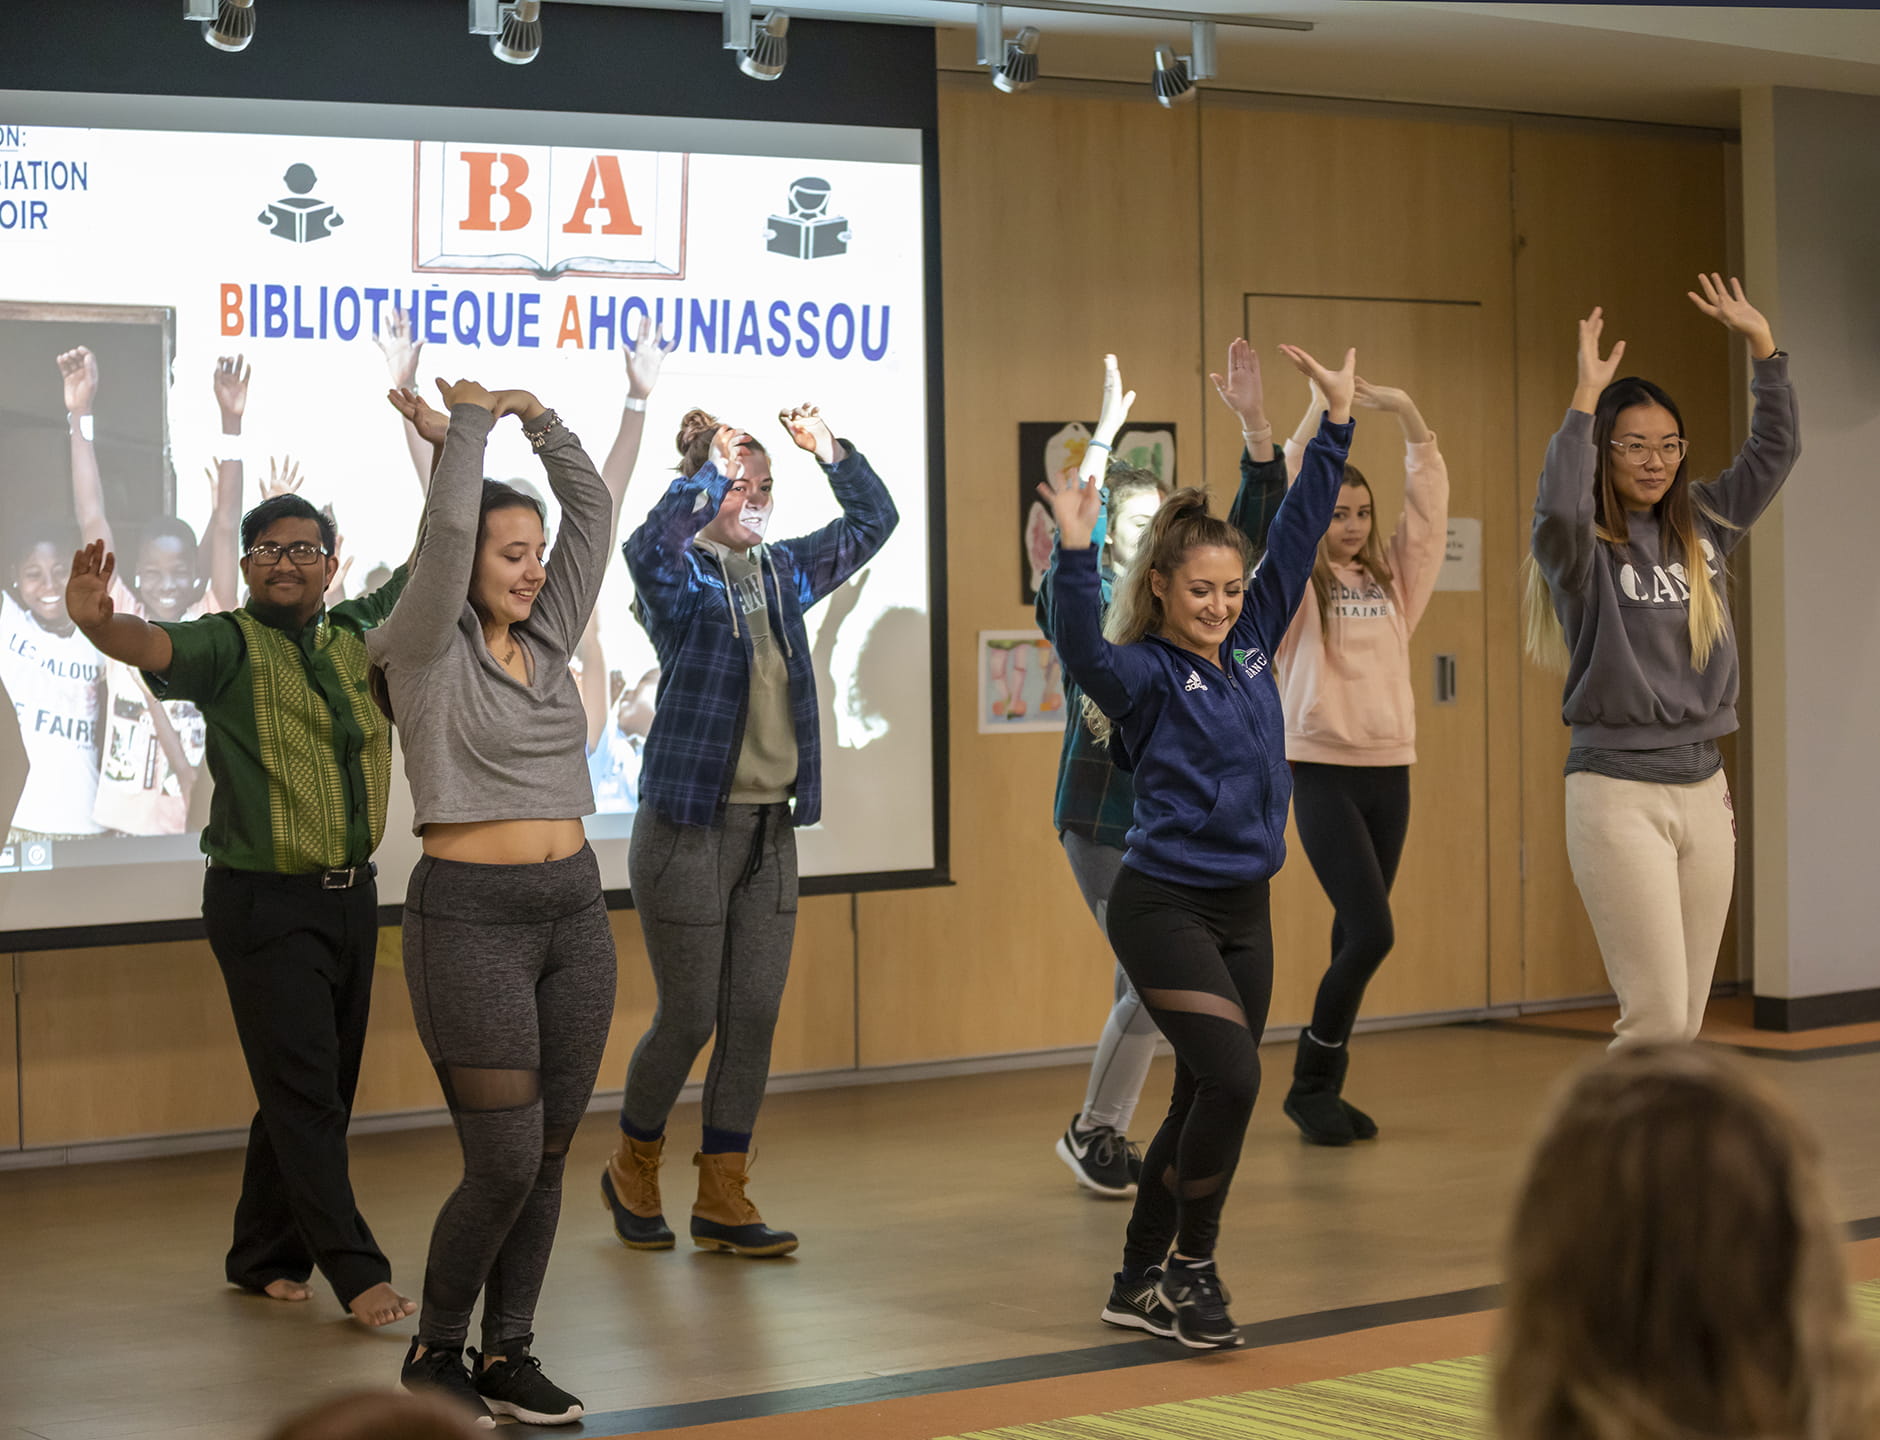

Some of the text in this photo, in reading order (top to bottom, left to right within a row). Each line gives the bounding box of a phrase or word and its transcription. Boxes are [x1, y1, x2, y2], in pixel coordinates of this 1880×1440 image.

[0, 160, 88, 191] IATION
[459, 151, 642, 235] B A
[556, 294, 891, 361] AHOUNIASSOU
